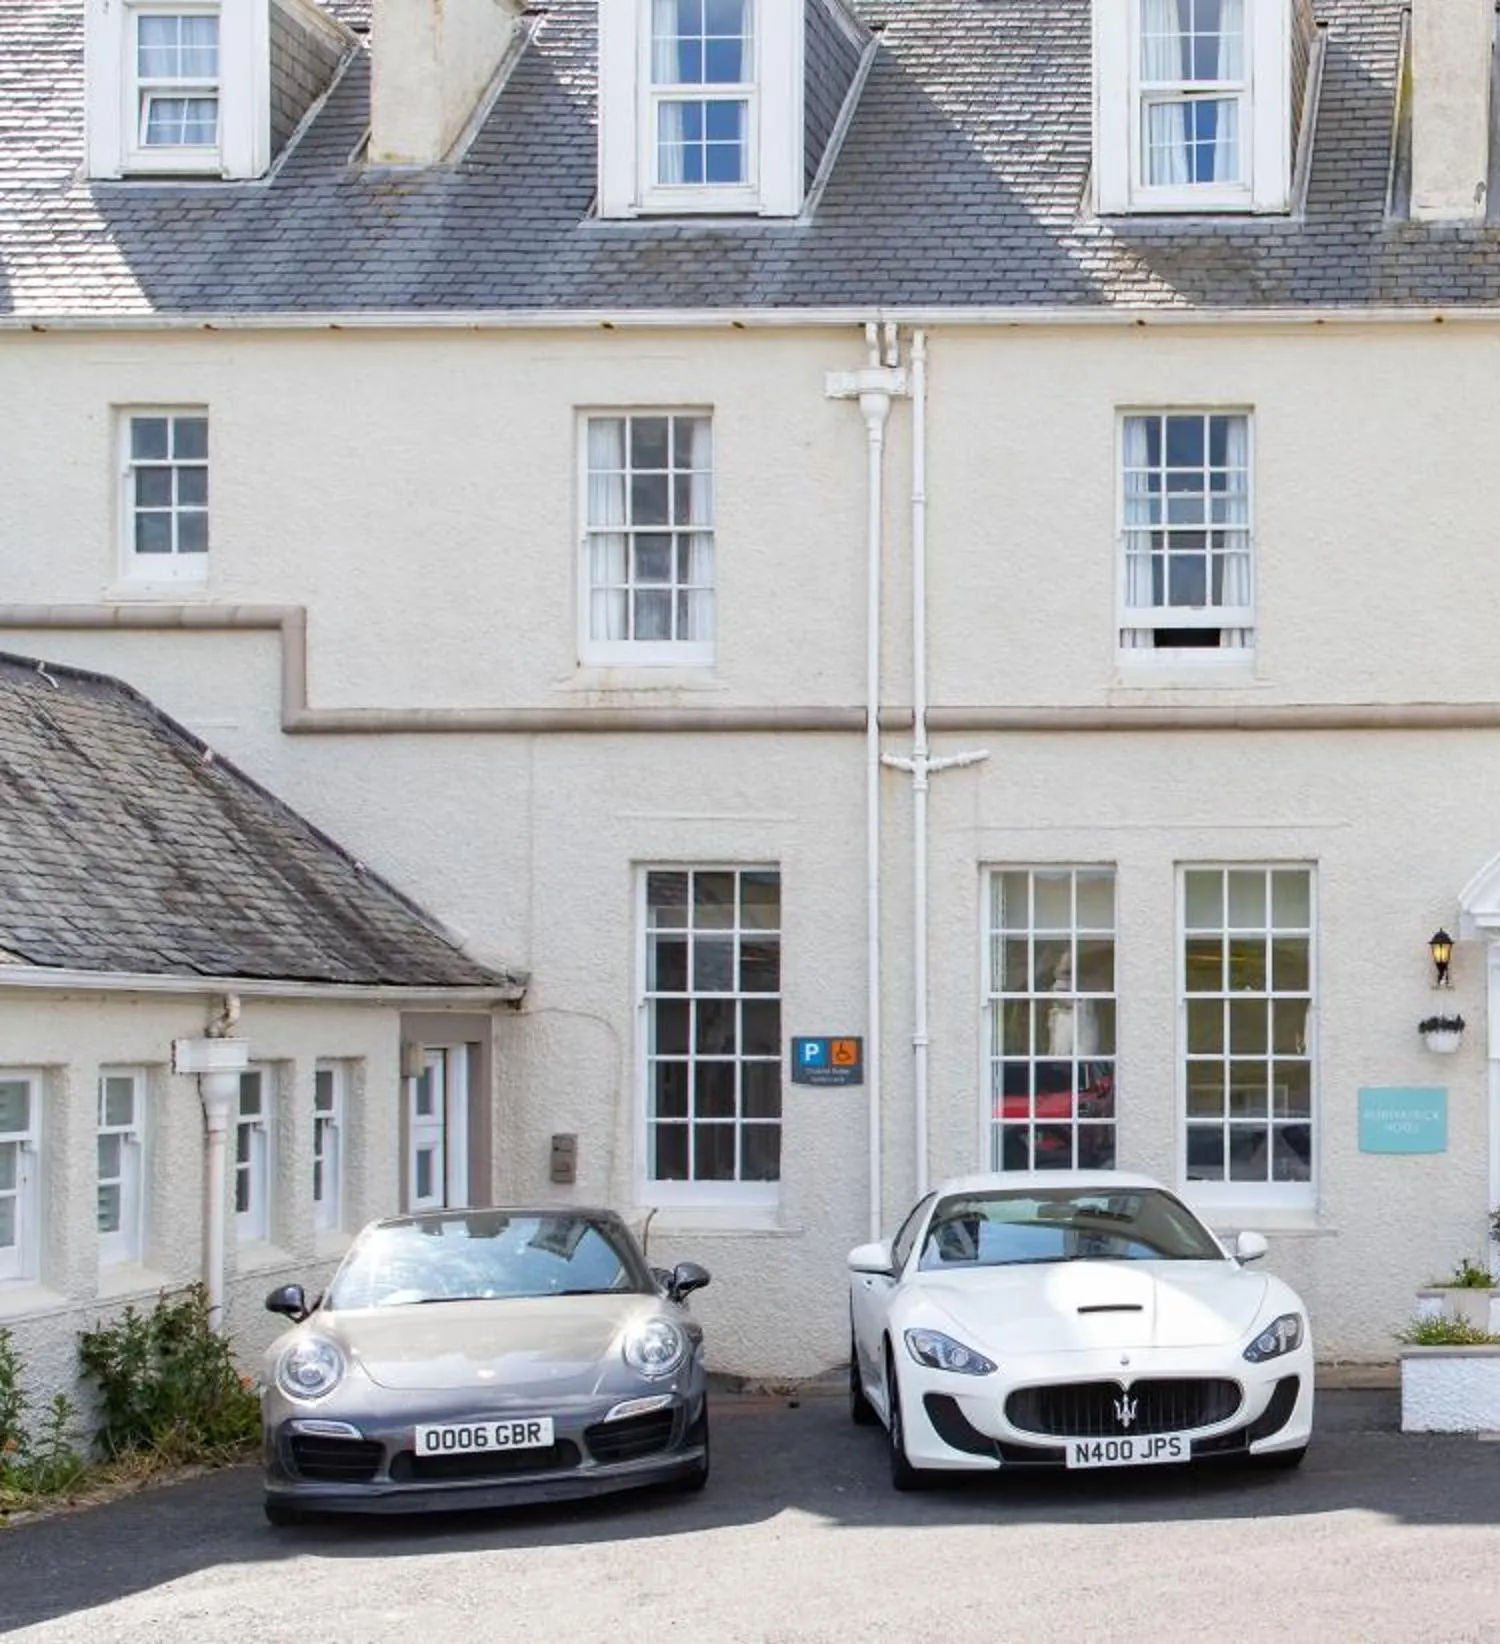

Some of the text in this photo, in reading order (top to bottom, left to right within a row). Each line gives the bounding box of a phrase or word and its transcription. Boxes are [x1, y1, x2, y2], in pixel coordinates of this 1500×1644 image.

[805, 1043, 819, 1061] P
[495, 1422, 541, 1445] GBR
[1075, 1437, 1181, 1463] N400 JPS
